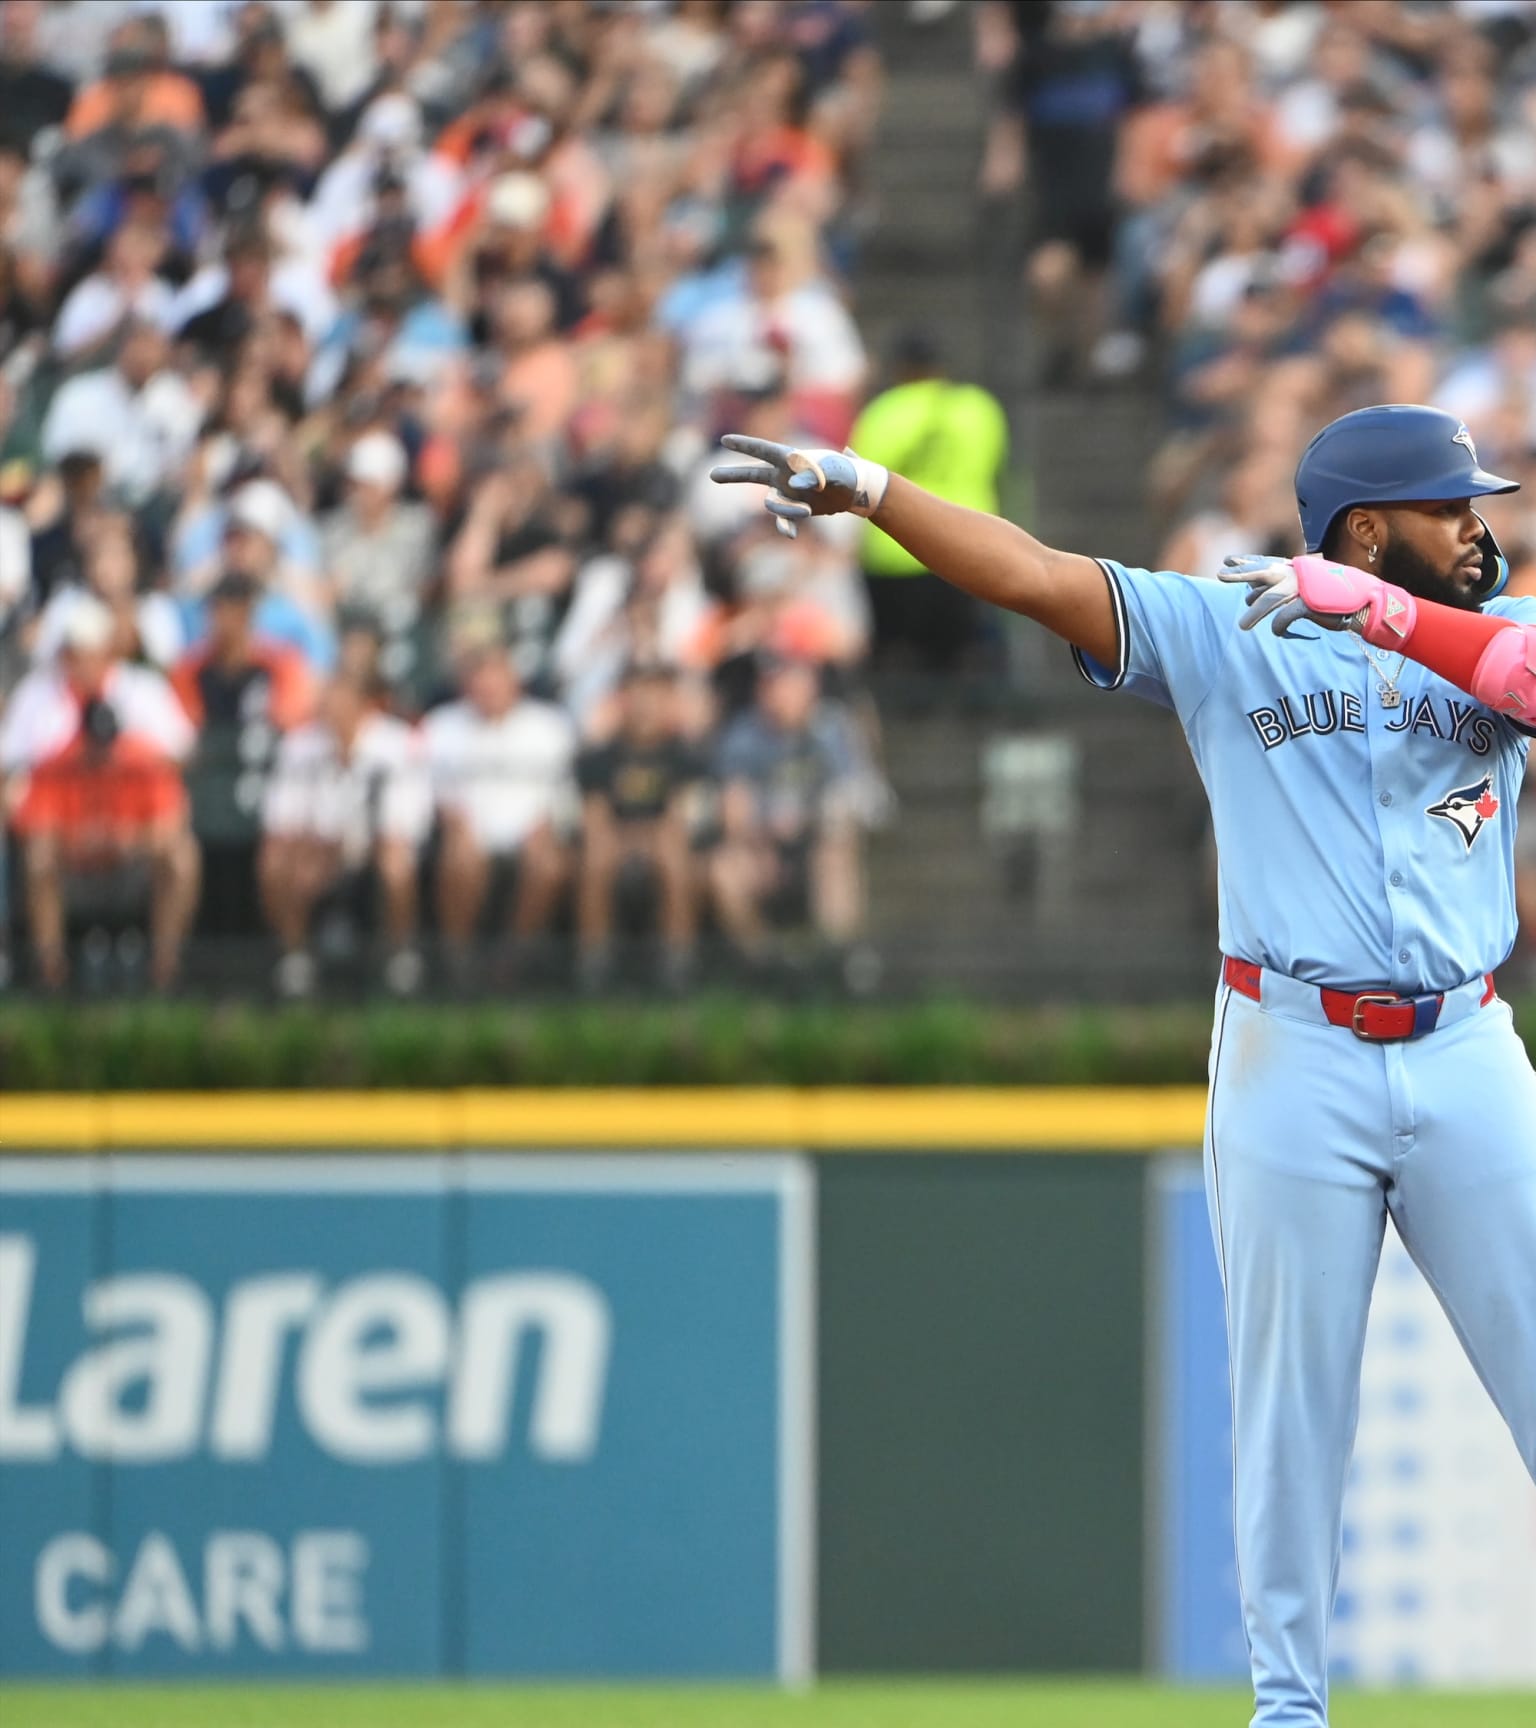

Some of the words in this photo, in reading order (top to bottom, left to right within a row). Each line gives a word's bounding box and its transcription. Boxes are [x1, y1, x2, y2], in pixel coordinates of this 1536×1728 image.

[1247, 690, 1365, 751] BLUE
[1385, 695, 1495, 755] JAYS
[35, 1531, 366, 1651] CARE
